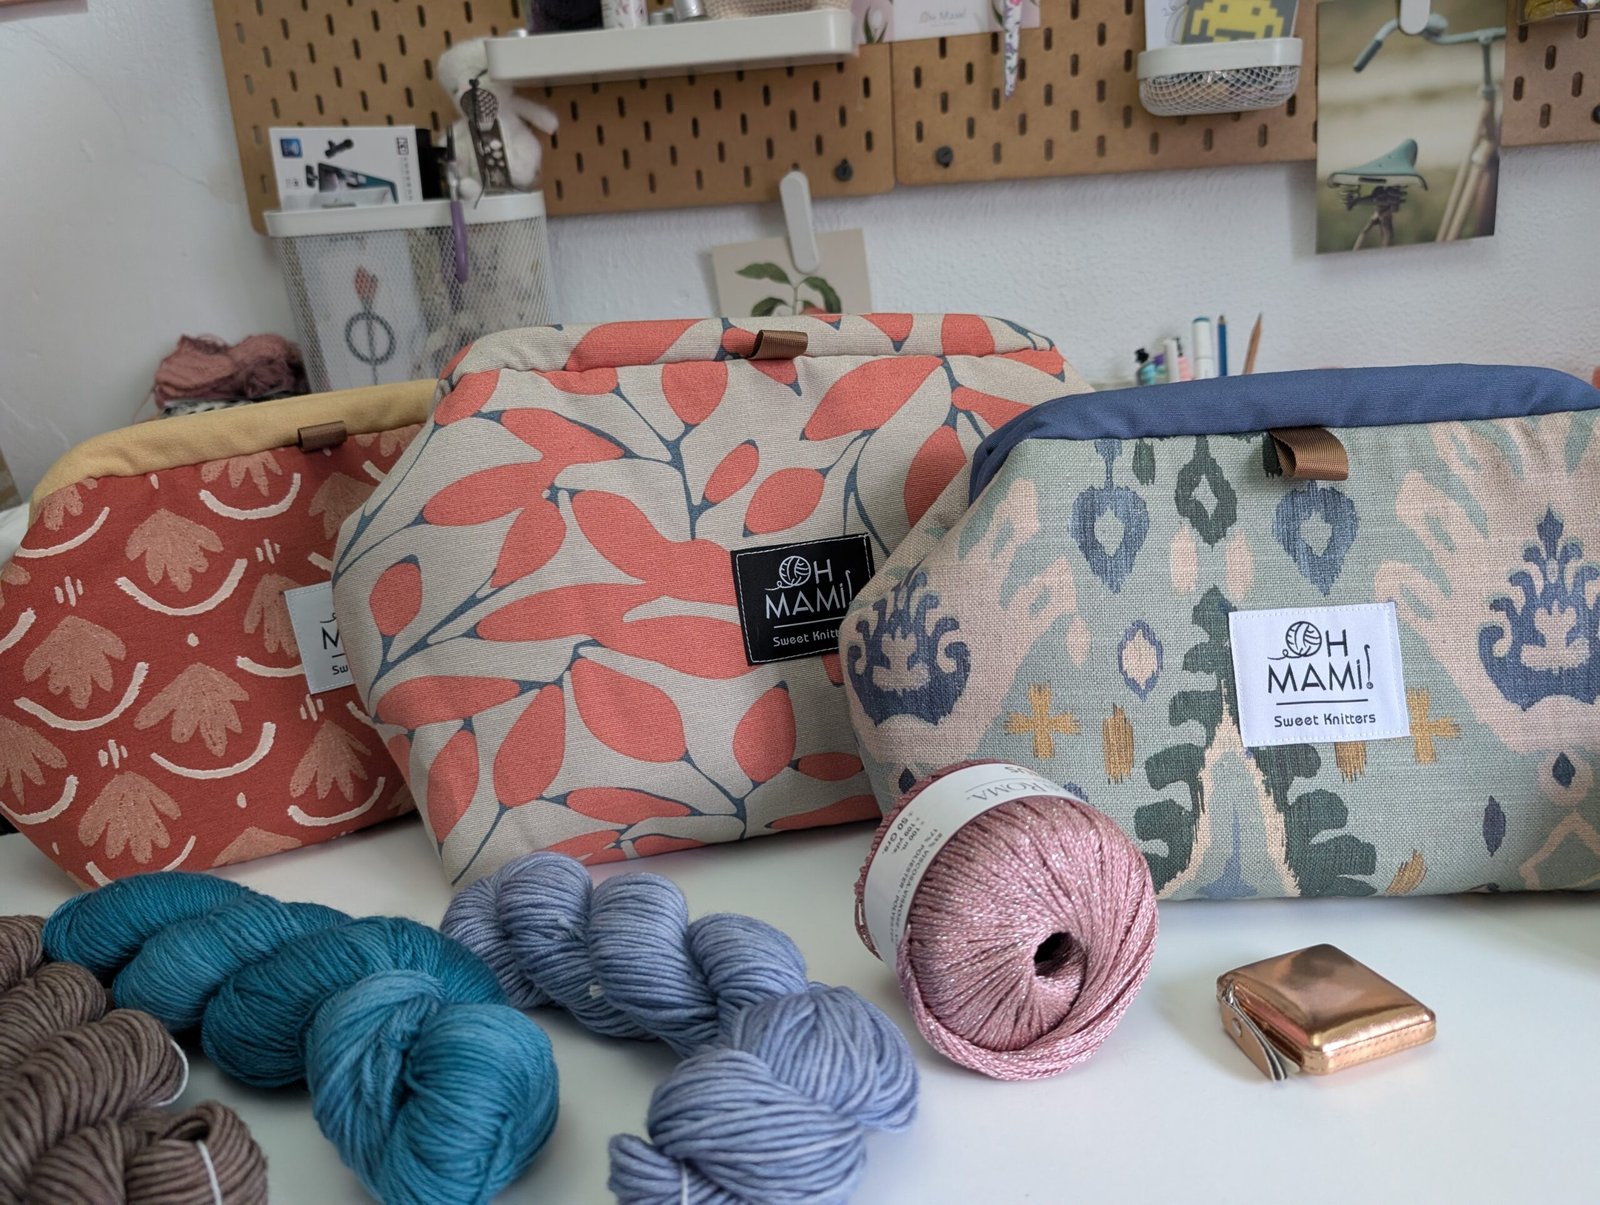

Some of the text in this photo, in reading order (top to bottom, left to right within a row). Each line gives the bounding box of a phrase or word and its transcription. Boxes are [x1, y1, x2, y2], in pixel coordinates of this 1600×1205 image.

[773, 629, 840, 647] Sweet Knitt
[1285, 620, 1348, 658] OH
[1274, 713, 1376, 728] Sweet Knitters
[897, 817, 908, 831] 50
